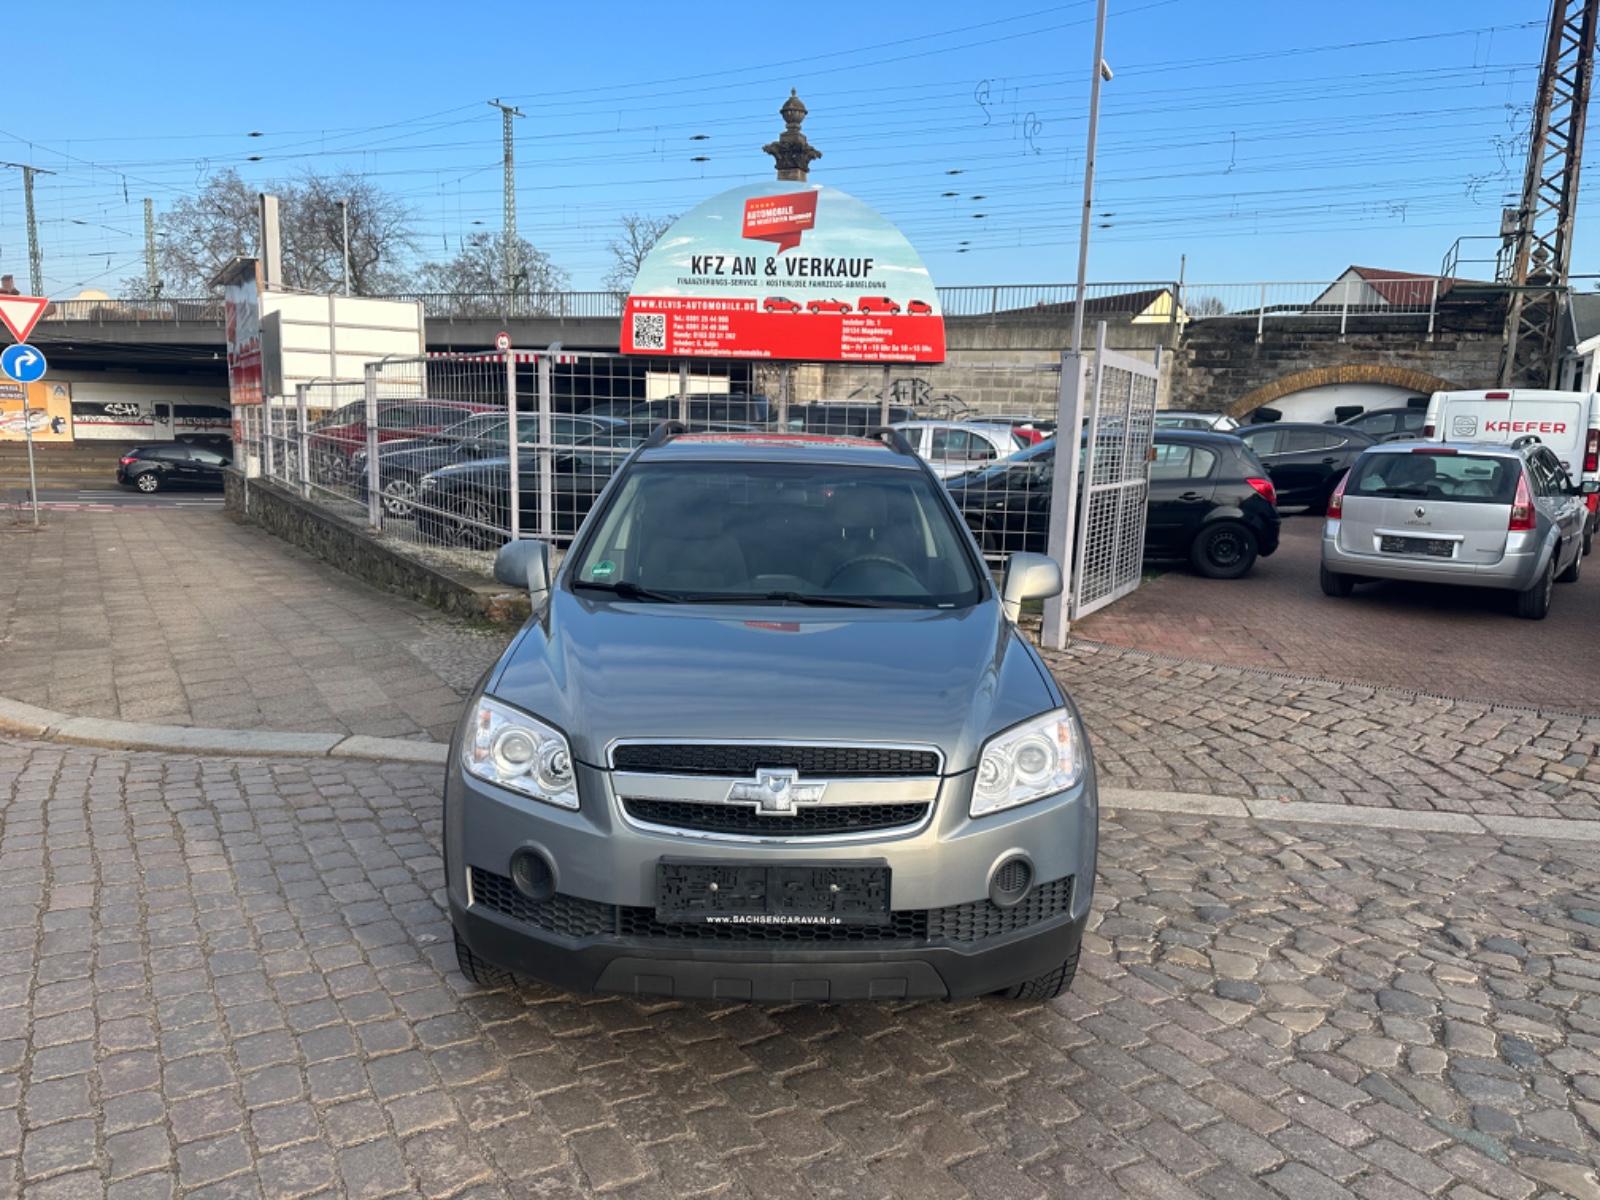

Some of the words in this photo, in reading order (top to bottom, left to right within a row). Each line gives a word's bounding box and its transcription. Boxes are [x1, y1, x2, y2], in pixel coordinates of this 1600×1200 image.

[691, 255, 724, 275] KFZ
[732, 256, 756, 275] AN
[764, 256, 777, 276] &
[785, 257, 874, 278] VERKAUF
[677, 277, 758, 287] FINANZIERUNGS-SERVICE
[766, 279, 807, 288] KOSTENLOSE
[808, 280, 887, 290] FAHRZEUG-ABMELDUNG
[633, 299, 756, 312] WWW.ELVIS-AUTOMOBILE.DE
[1484, 420, 1567, 433] KAEFER
[706, 914, 842, 926] www.SACHSENCARAVAN.de
